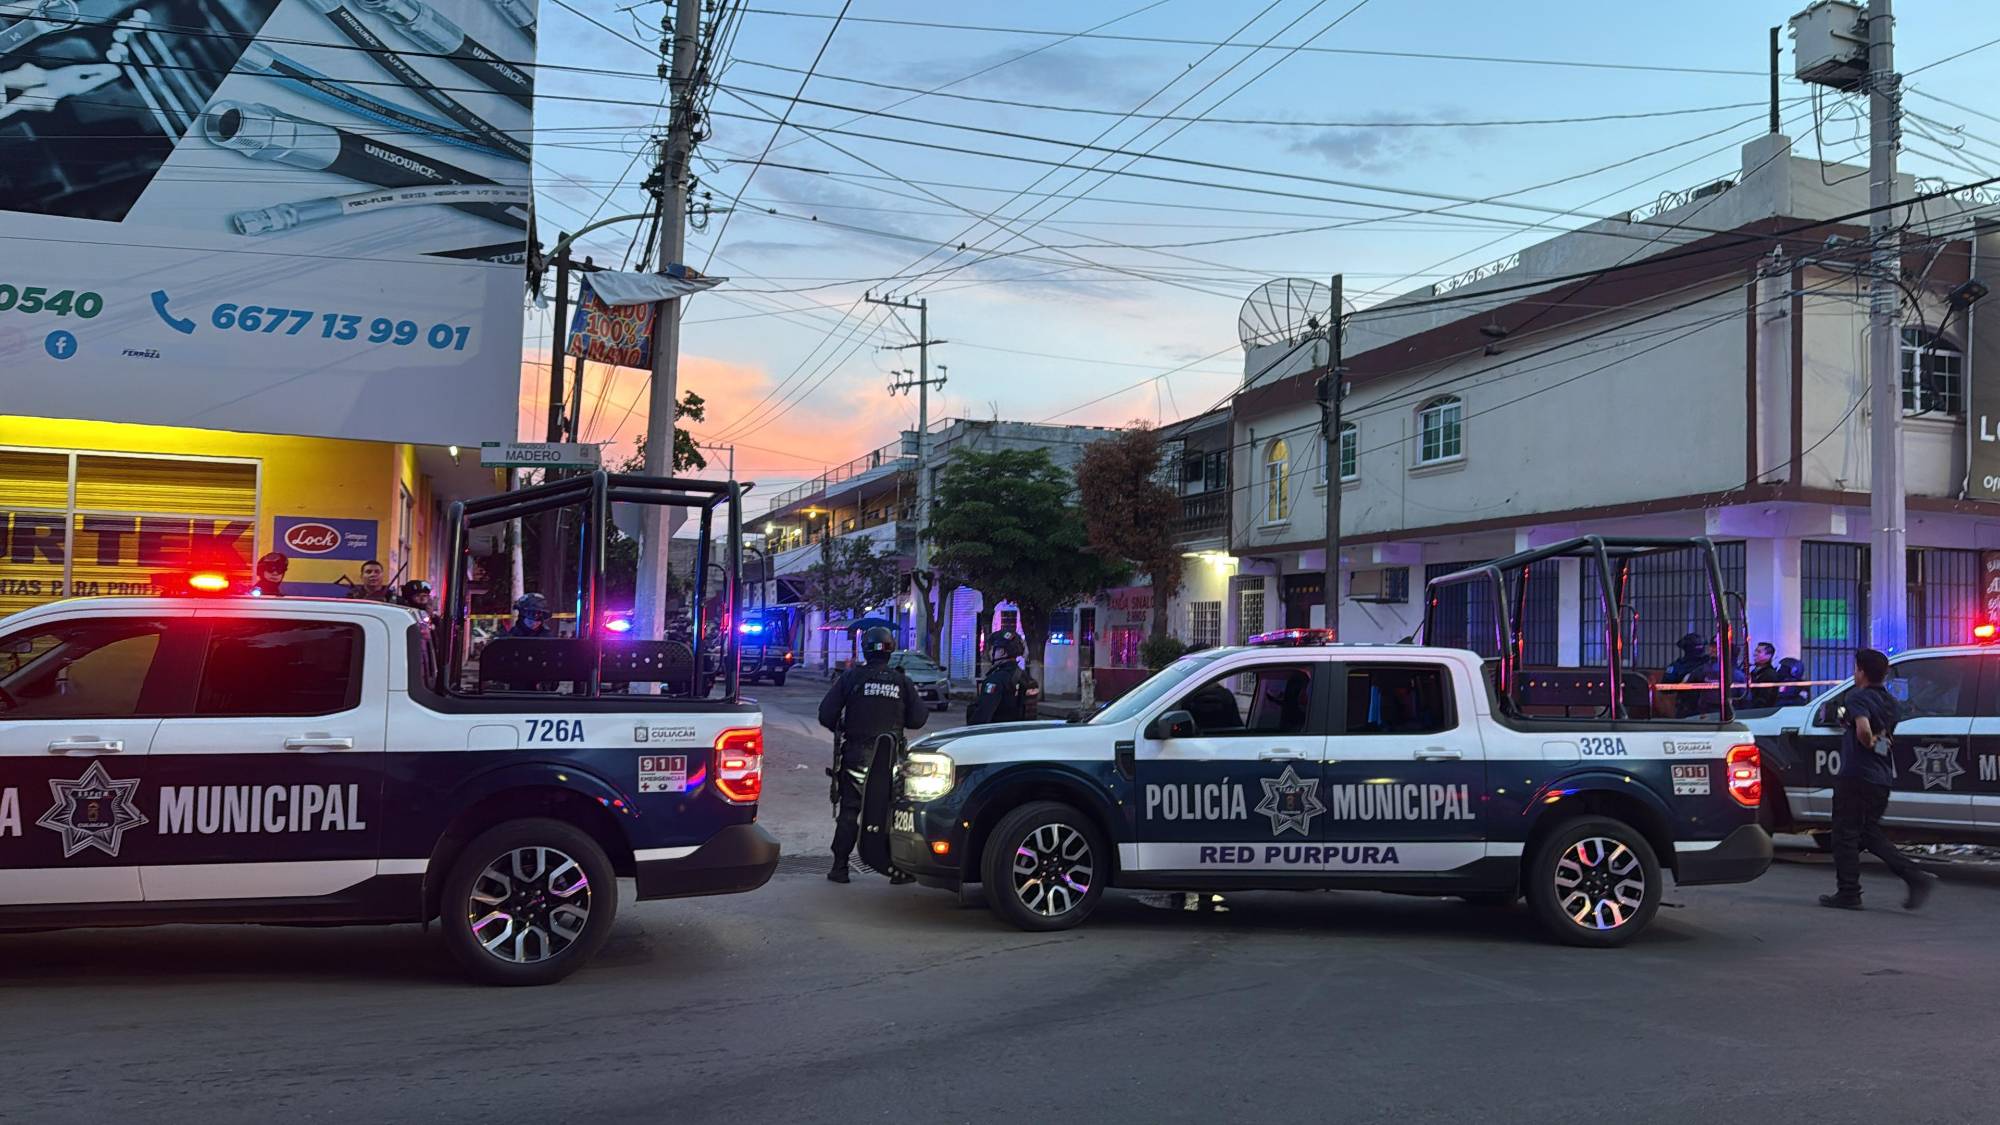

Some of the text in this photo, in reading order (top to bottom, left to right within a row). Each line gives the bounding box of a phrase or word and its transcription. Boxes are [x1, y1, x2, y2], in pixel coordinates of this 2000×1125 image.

[364, 143, 442, 180] UNISOURCE
[0, 284, 104, 319] 0540
[211, 303, 471, 351] 6677 13 99 01
[585, 312, 637, 346] 100%
[505, 450, 562, 461] MADERO
[292, 529, 335, 547] Lock
[864, 682, 900, 692] POLICÍA
[864, 689, 900, 699] ESTATAL
[525, 720, 585, 743] 726A
[1580, 737, 1628, 756] 328A
[158, 783, 367, 835] MUNICIPAL
[1146, 777, 1476, 820] POLICÍA MUNICIPAL
[1200, 846, 1400, 865] RED PURPURA
